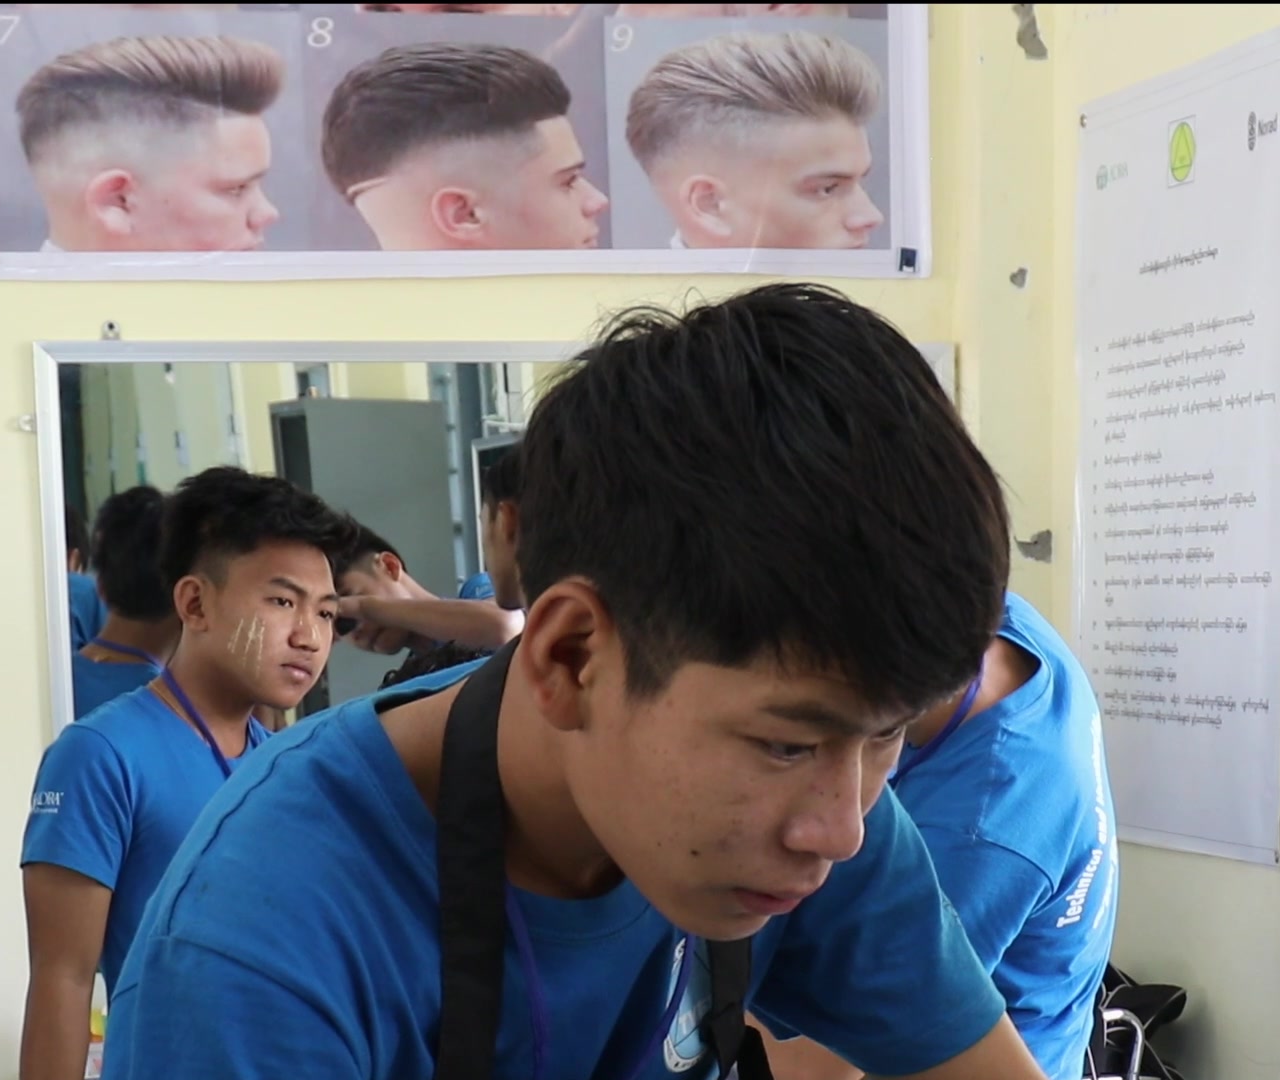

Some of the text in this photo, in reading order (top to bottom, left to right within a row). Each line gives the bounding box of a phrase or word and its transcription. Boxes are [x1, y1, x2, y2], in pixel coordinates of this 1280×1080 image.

[307, 17, 334, 47] 8
[610, 23, 633, 51] 9
[1258, 112, 1278, 137] Norad
